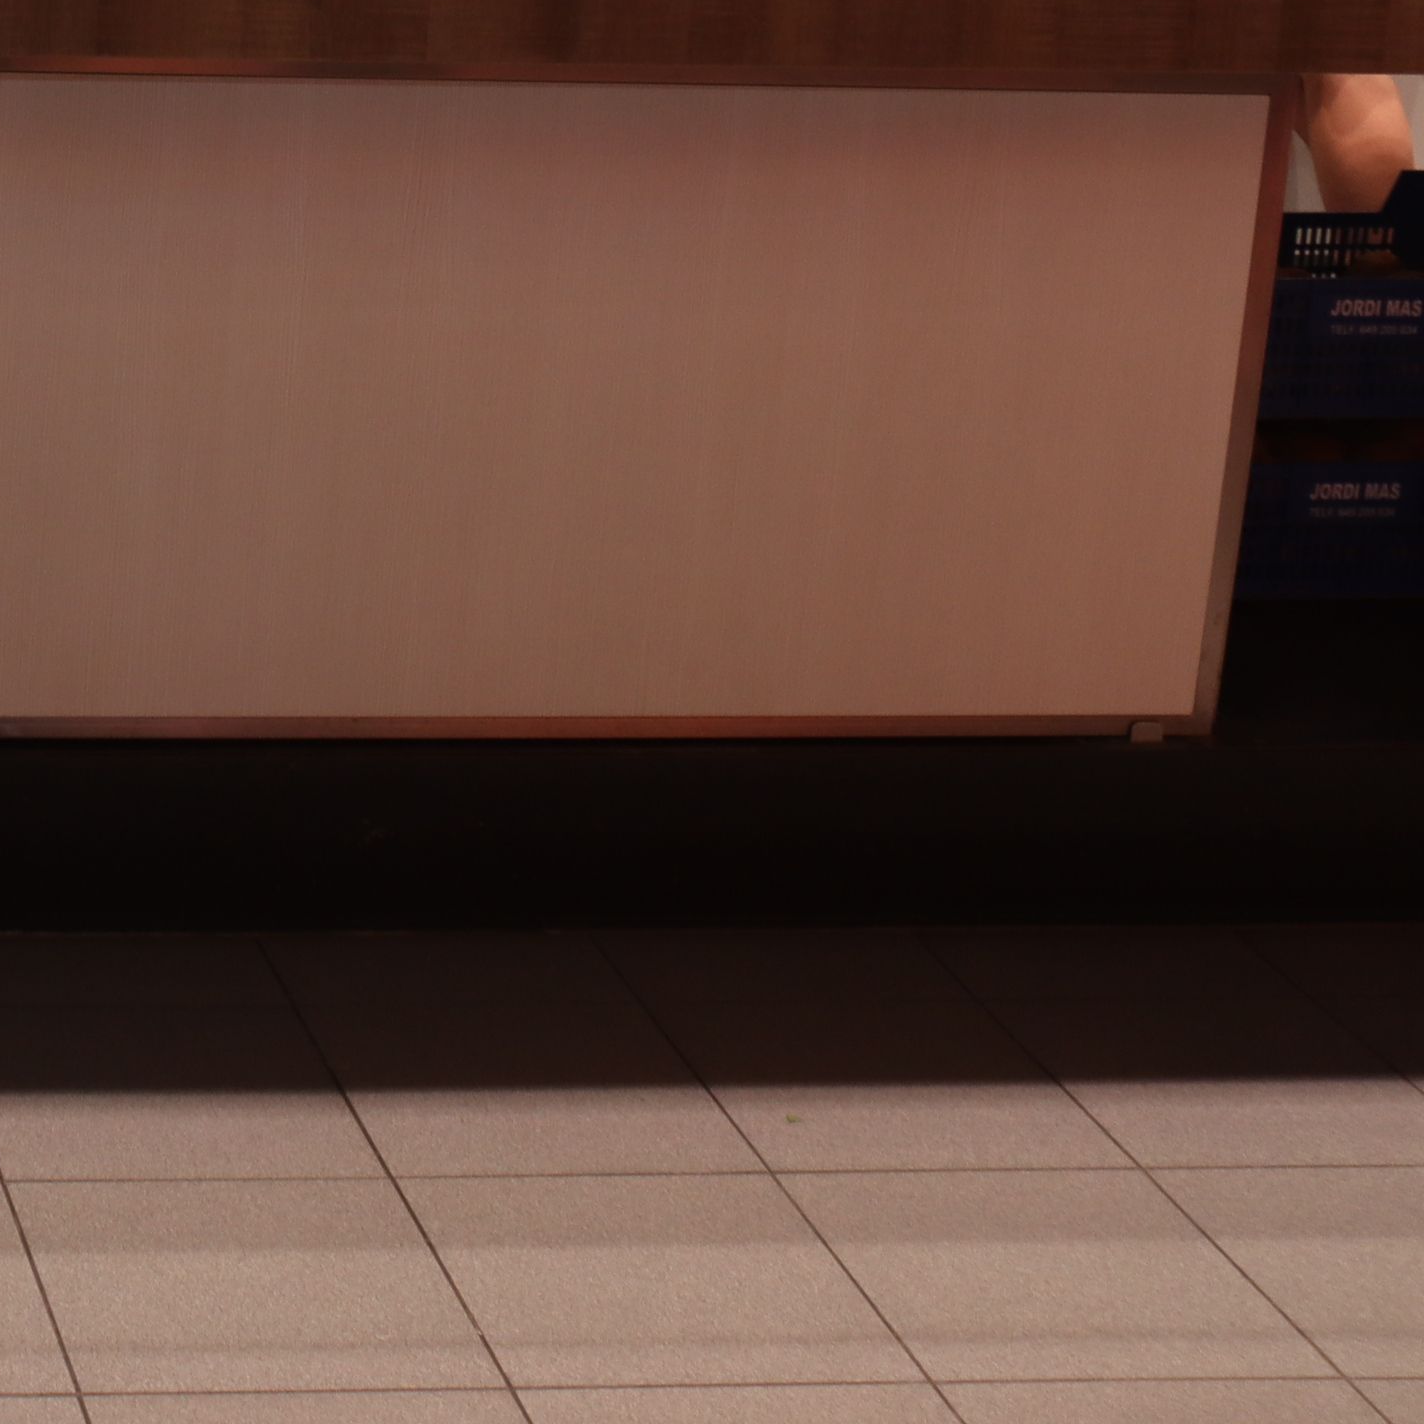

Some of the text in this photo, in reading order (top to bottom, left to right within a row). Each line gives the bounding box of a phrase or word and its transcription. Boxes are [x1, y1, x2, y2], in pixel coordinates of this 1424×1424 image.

[1331, 299, 1422, 316] JORDI MAS
[1310, 482, 1402, 501] JORDI MAS
